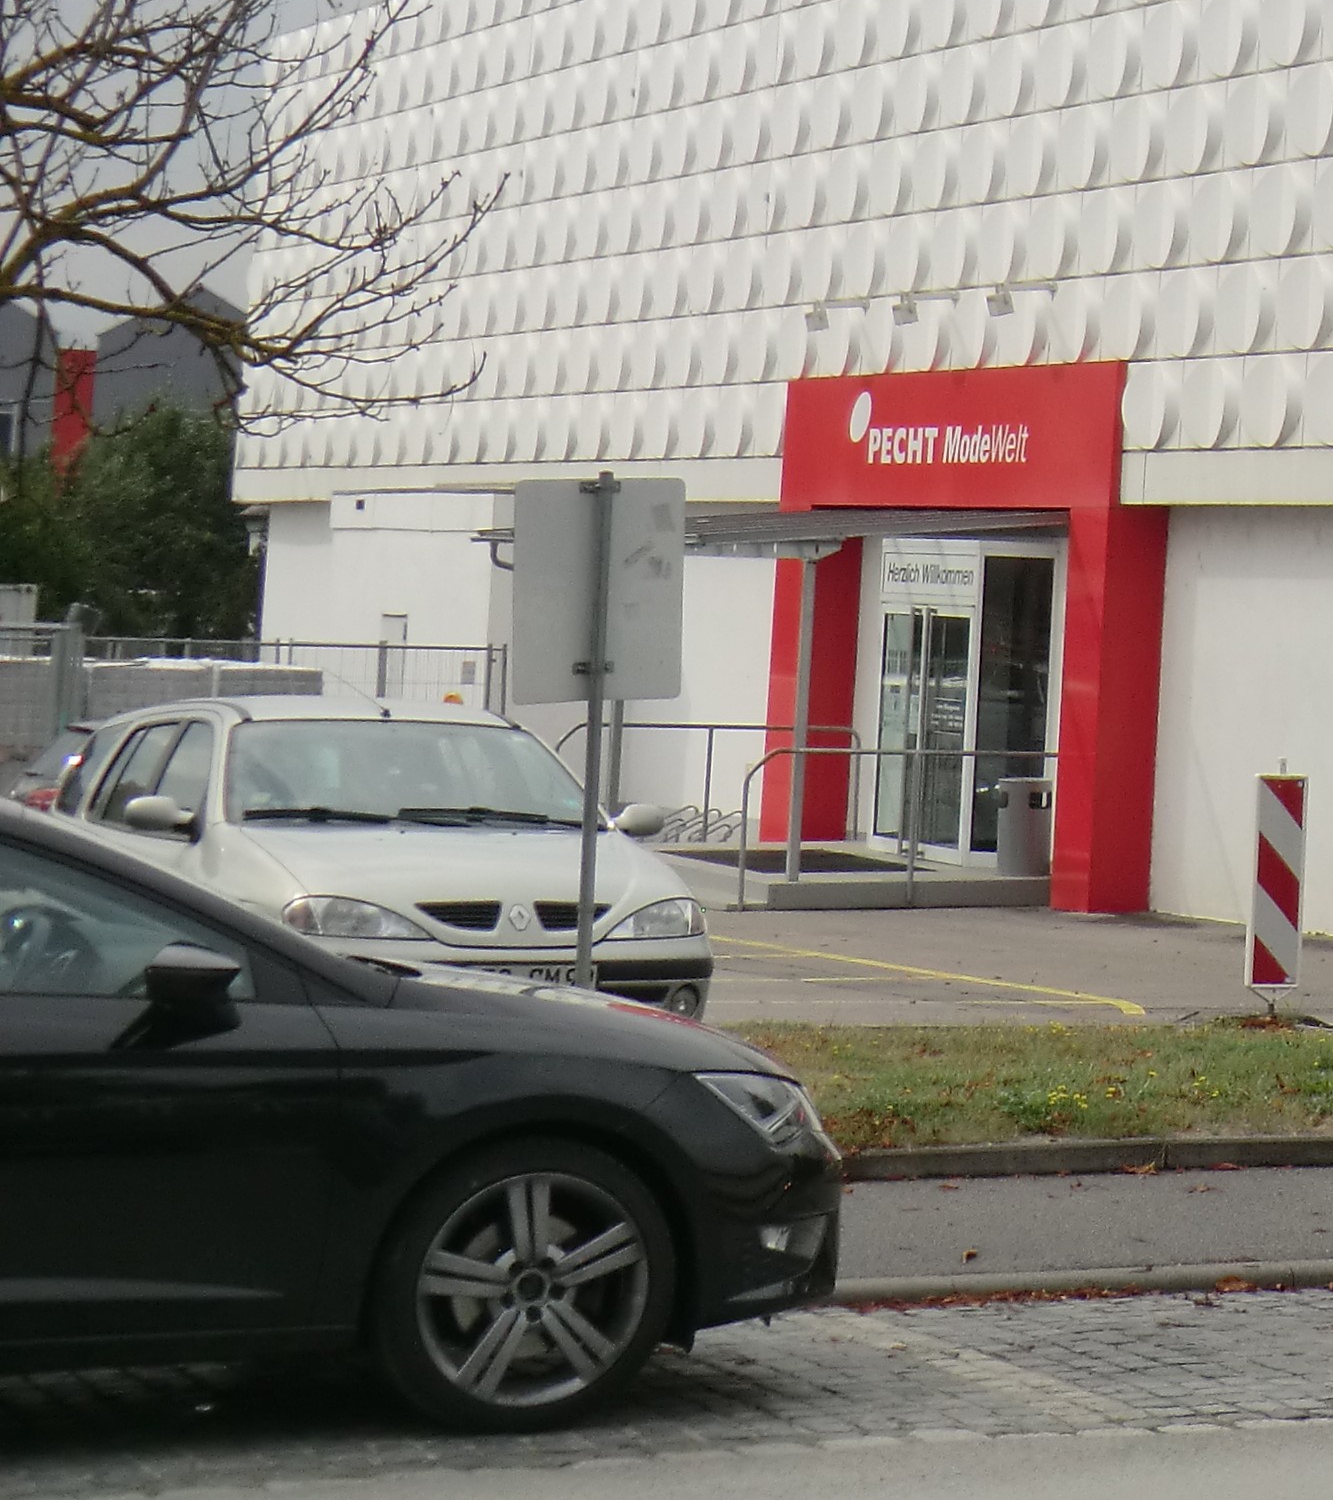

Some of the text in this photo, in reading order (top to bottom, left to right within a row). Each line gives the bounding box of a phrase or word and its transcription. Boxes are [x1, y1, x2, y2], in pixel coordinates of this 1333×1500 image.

[867, 424, 1029, 464] PECHT ModeWelt
[887, 562, 974, 585] Herzlich Willkommen
